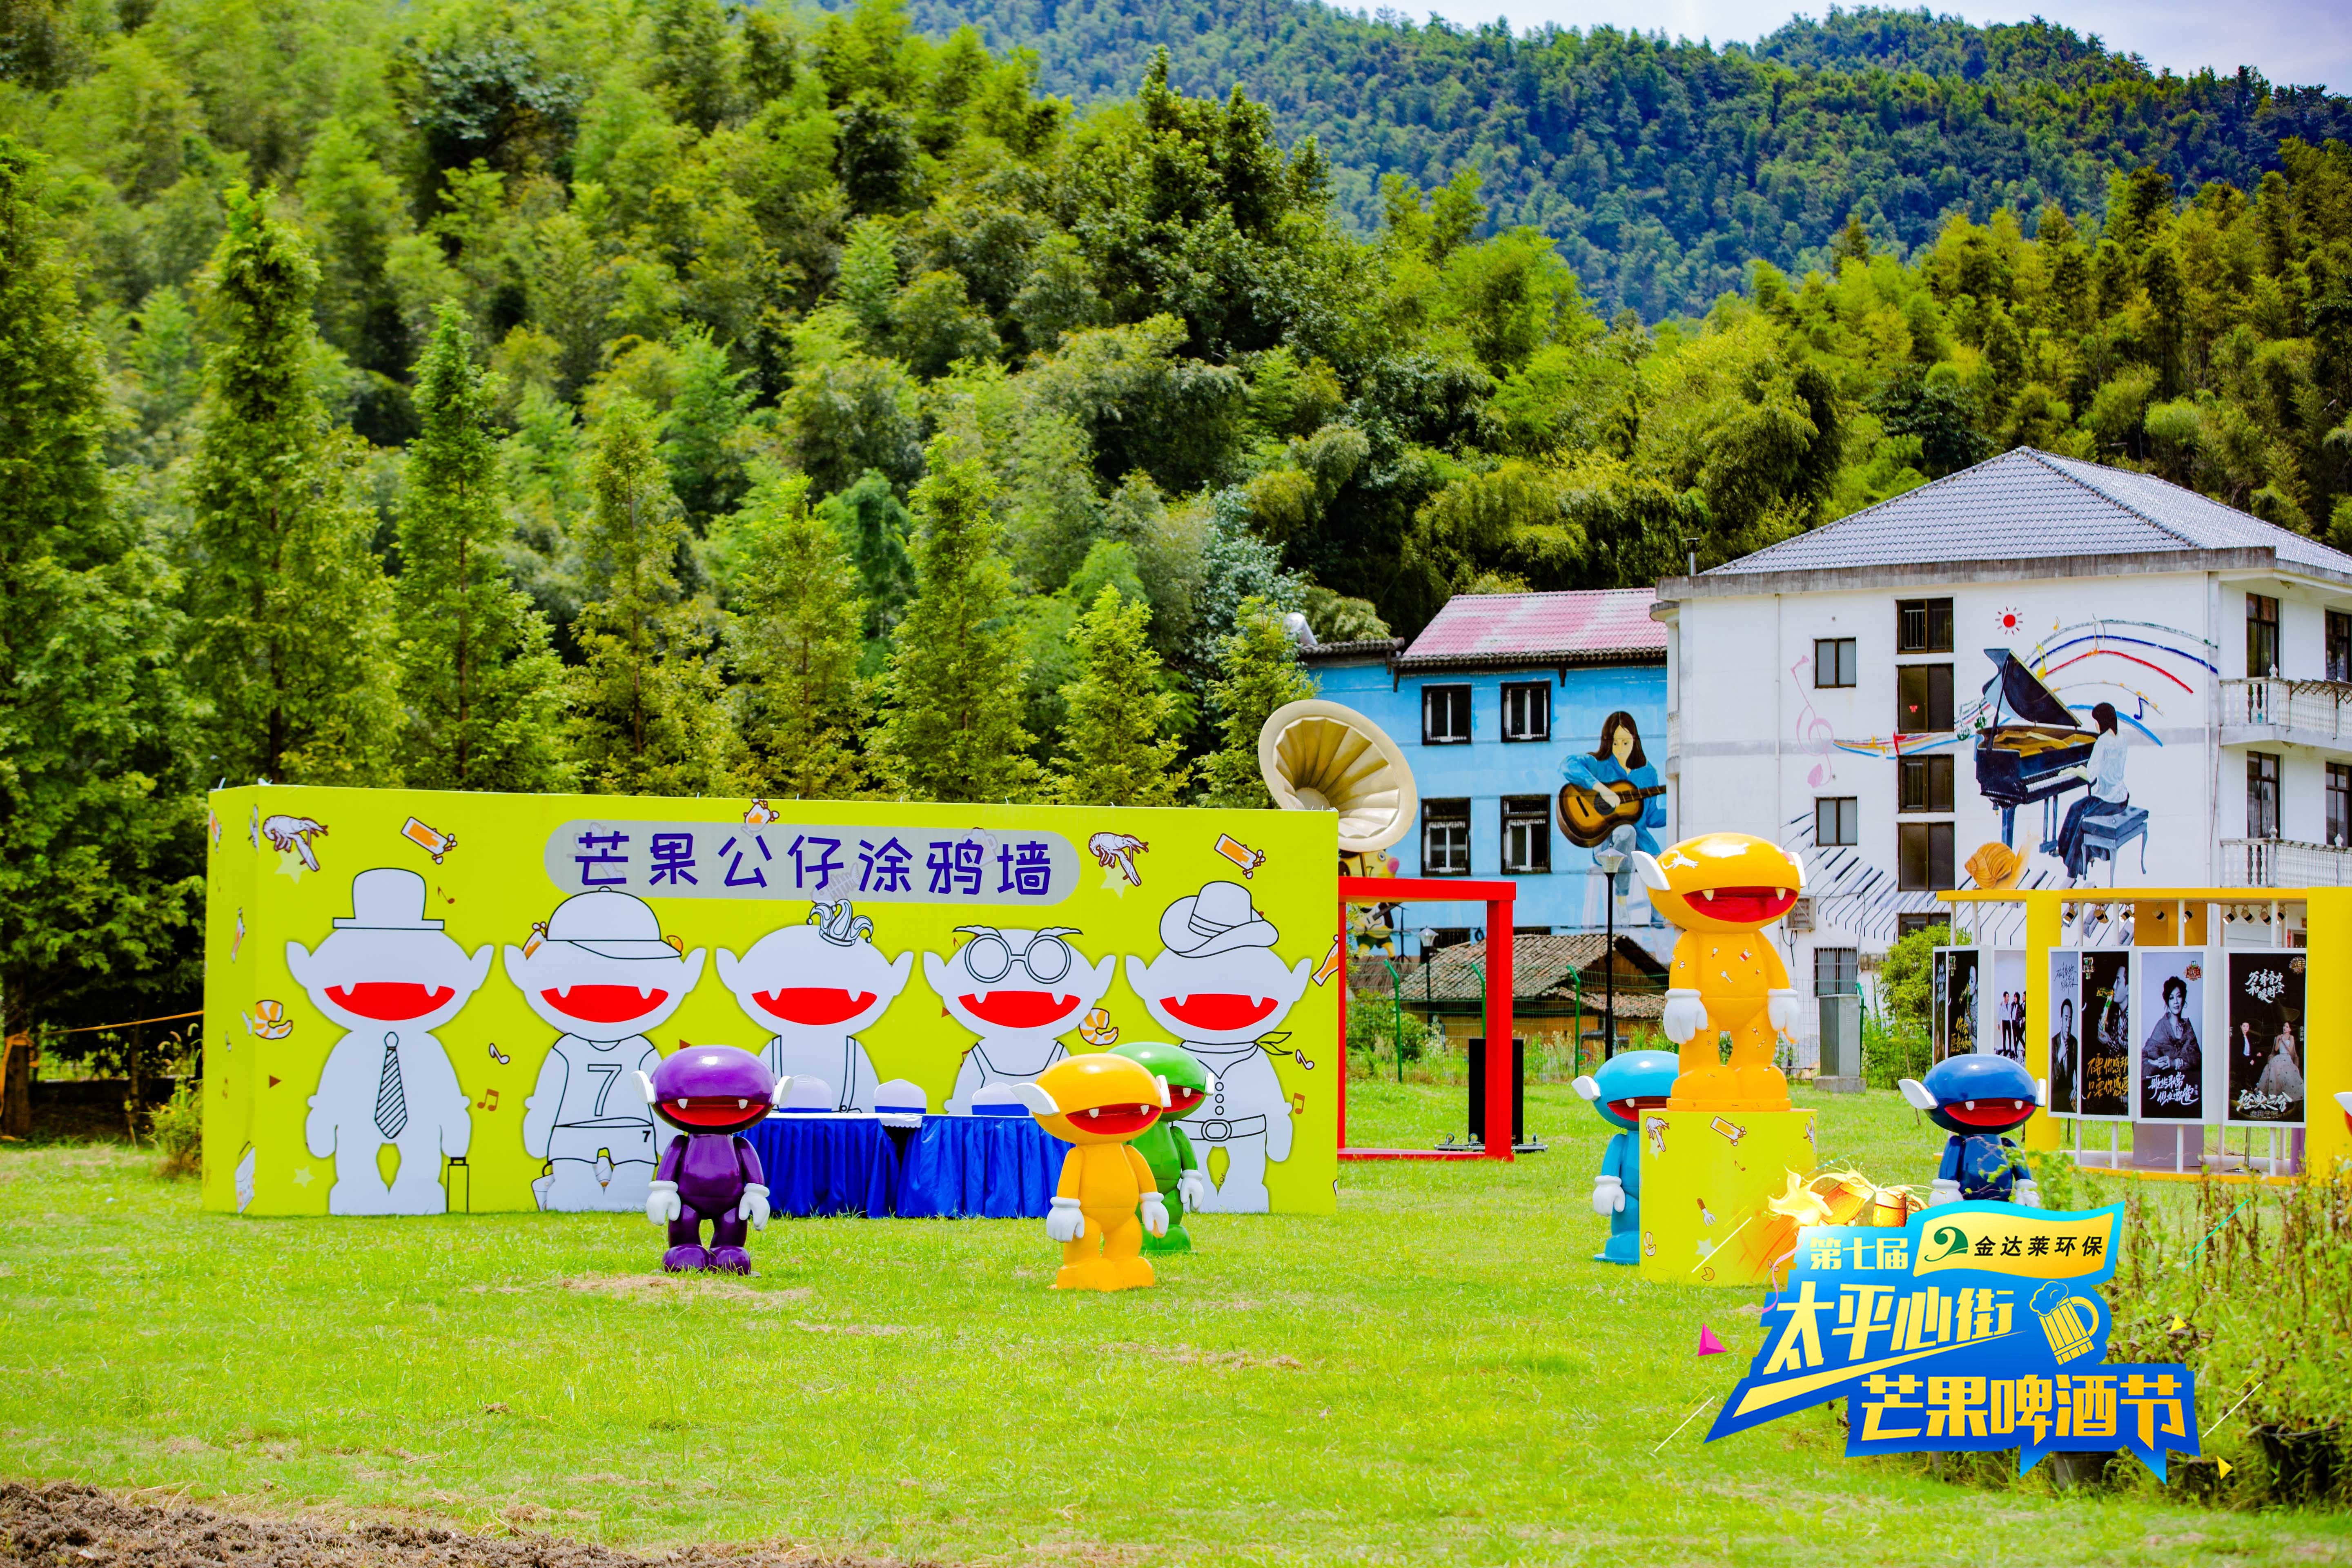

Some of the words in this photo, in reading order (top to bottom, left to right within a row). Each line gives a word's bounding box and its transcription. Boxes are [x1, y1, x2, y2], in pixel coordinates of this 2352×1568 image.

[575, 831, 1051, 895] 芒果公仔涂鸦墙
[588, 1064, 622, 1117] 7
[642, 1130, 651, 1143] 7
